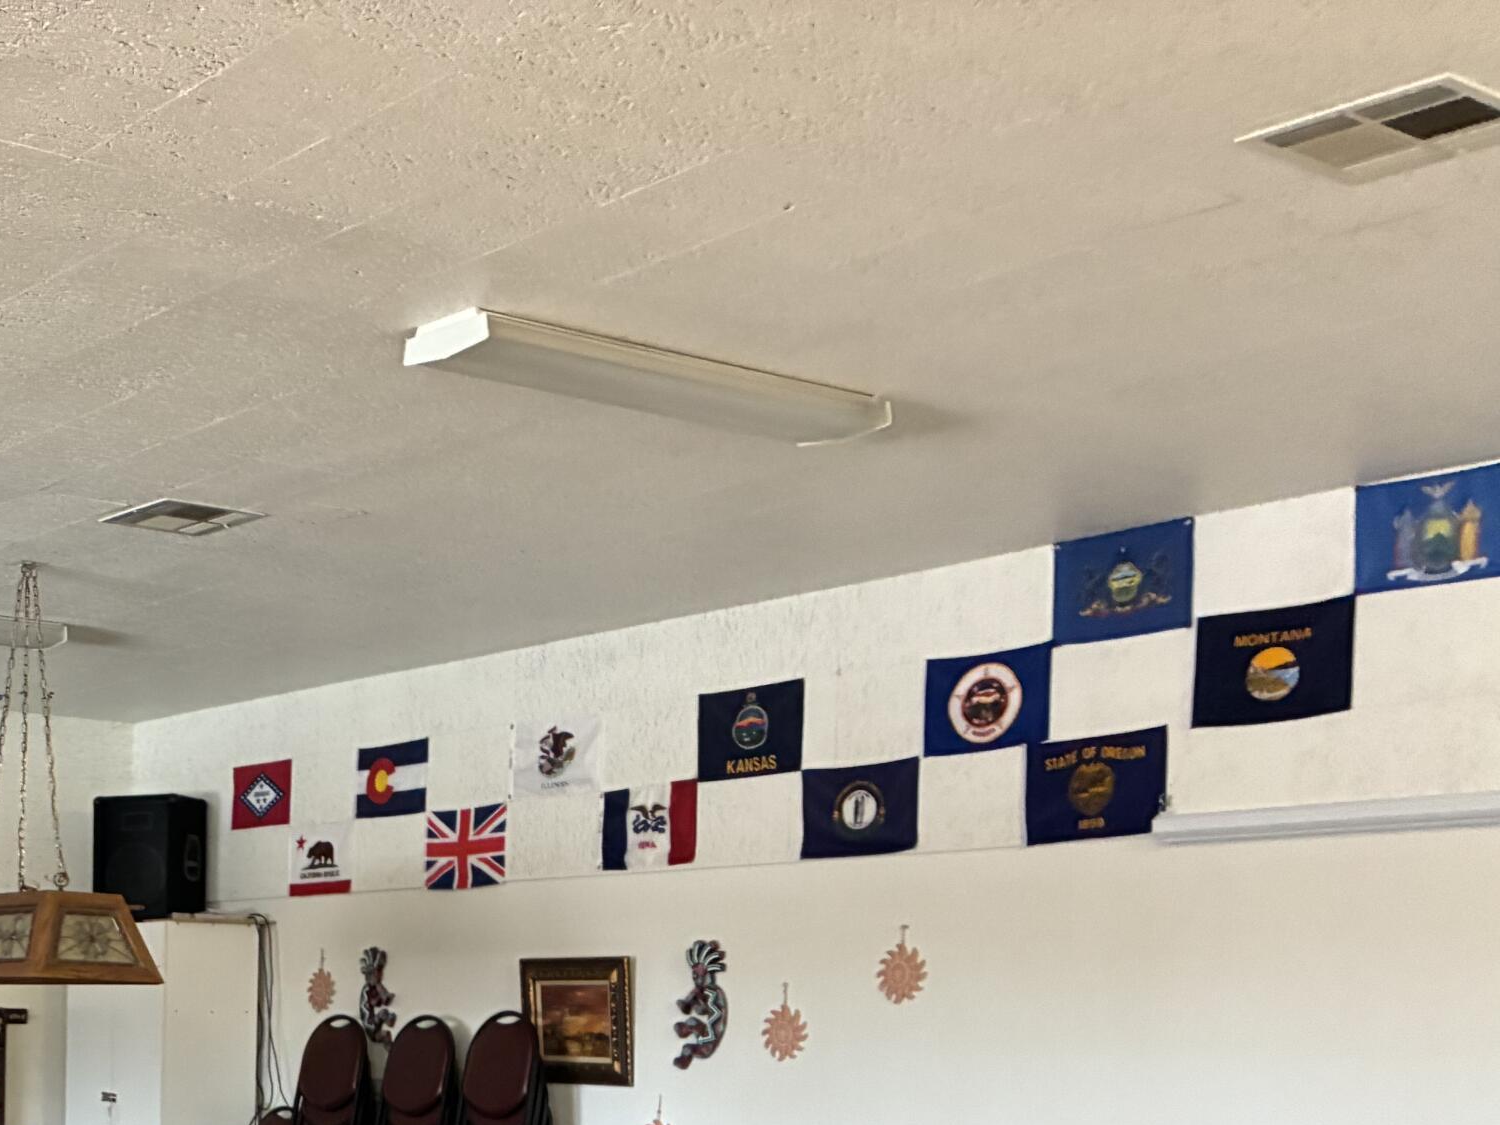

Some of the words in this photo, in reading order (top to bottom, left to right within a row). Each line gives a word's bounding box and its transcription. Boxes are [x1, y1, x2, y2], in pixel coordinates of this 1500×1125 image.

[1233, 627, 1312, 648] MONTANA
[726, 754, 777, 774] KANSAS
[1044, 750, 1077, 771] STATE
[1081, 746, 1096, 759] OF
